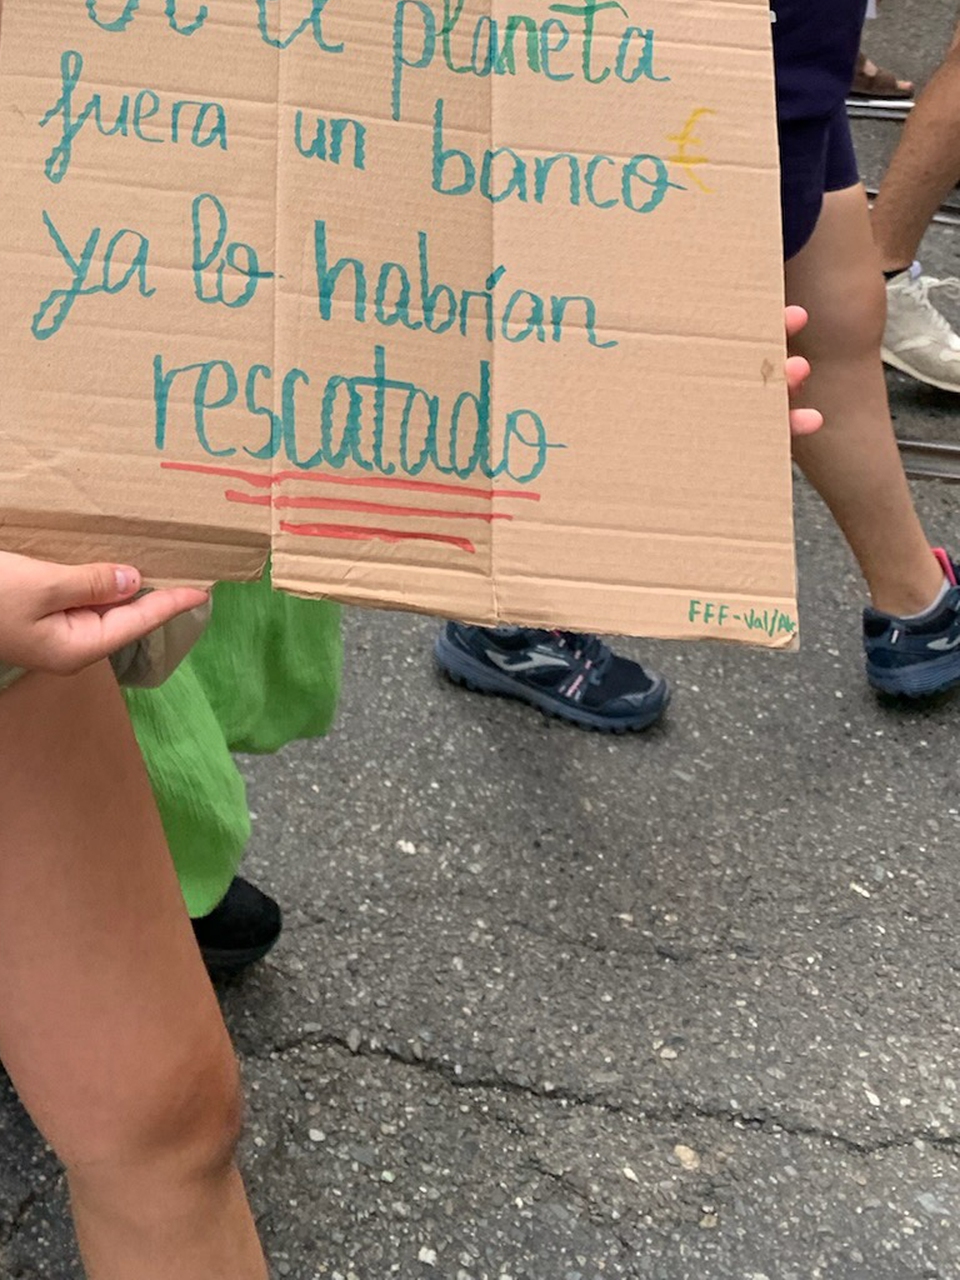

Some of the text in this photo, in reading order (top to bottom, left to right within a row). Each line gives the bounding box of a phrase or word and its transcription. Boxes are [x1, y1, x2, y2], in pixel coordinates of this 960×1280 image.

[38, 50, 228, 184] fuera
[294, 109, 367, 170] un
[431, 97, 687, 213] banco
[30, 193, 619, 349] ya lo habrían
[152, 344, 568, 484] rescatado
